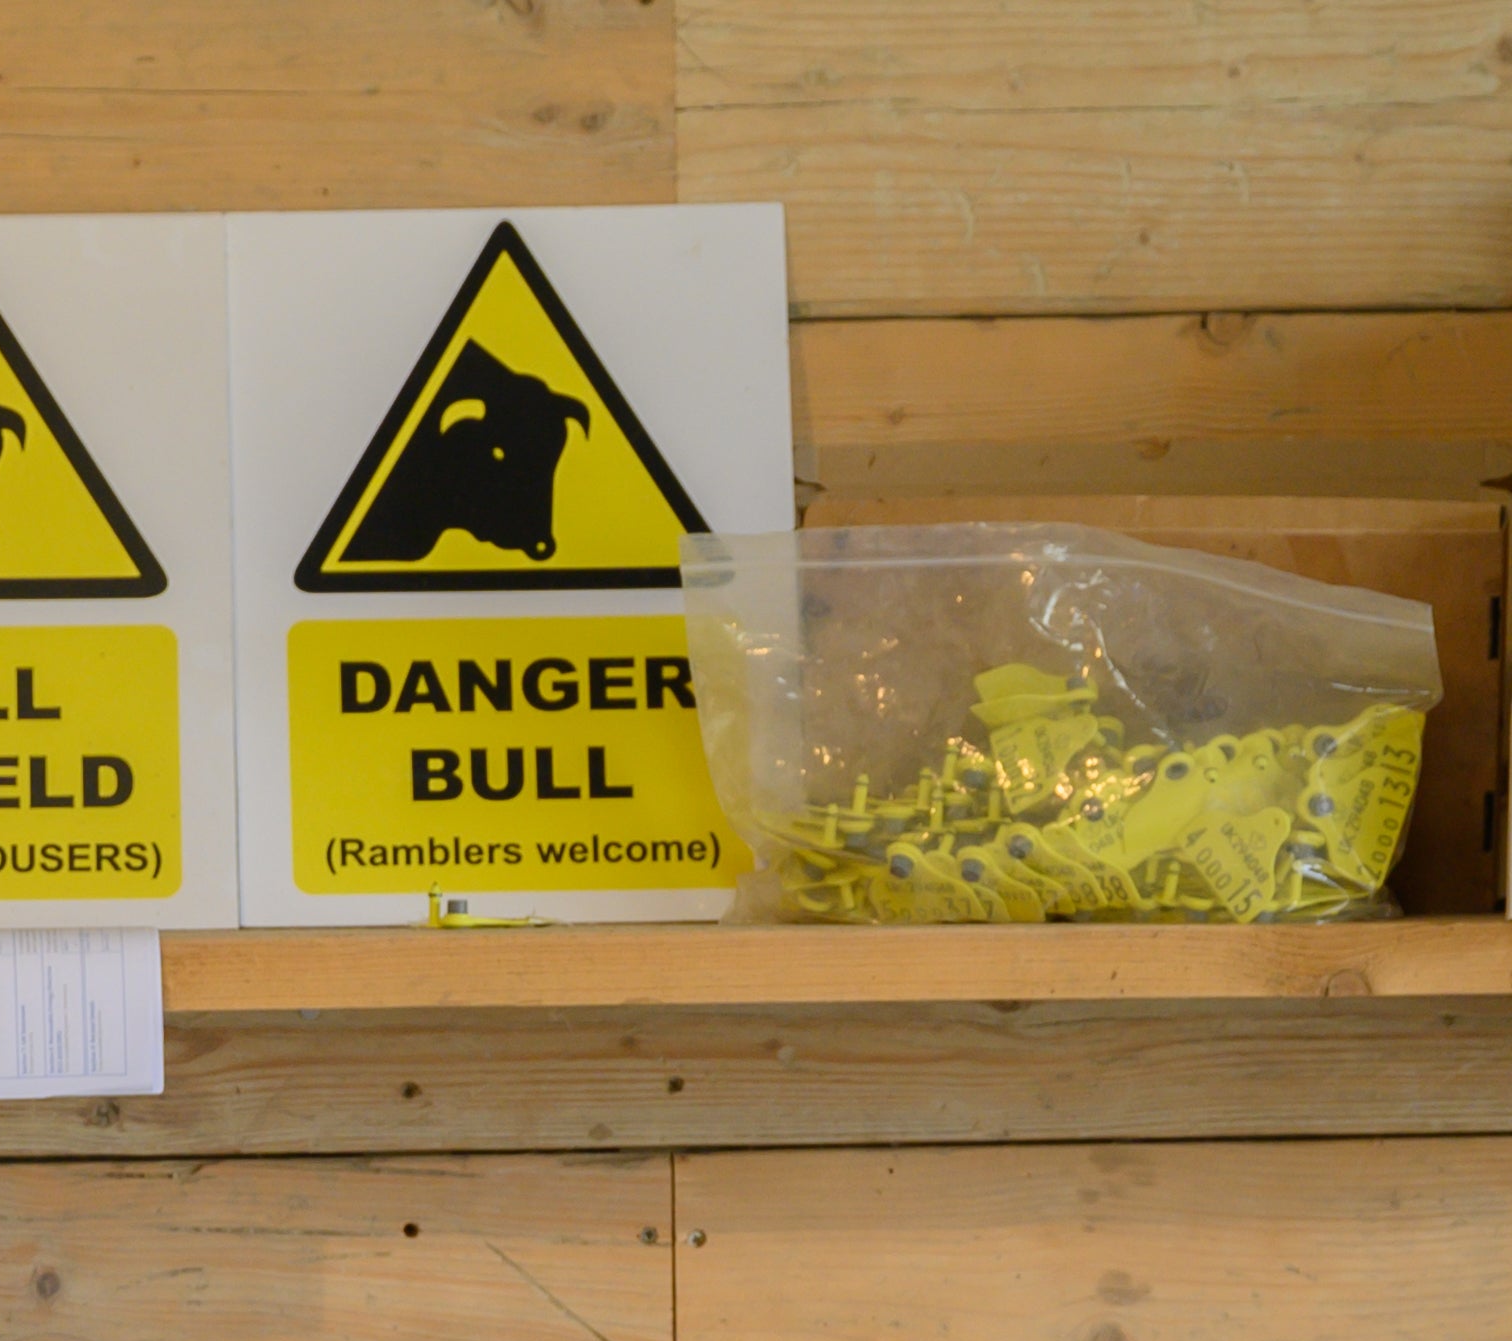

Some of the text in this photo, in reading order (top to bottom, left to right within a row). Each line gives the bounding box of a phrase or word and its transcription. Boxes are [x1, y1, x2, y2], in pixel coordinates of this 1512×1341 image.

[340, 656, 697, 714] DANGER
[411, 747, 633, 802] BULL
[325, 831, 721, 874] (Ramblers welcome)
